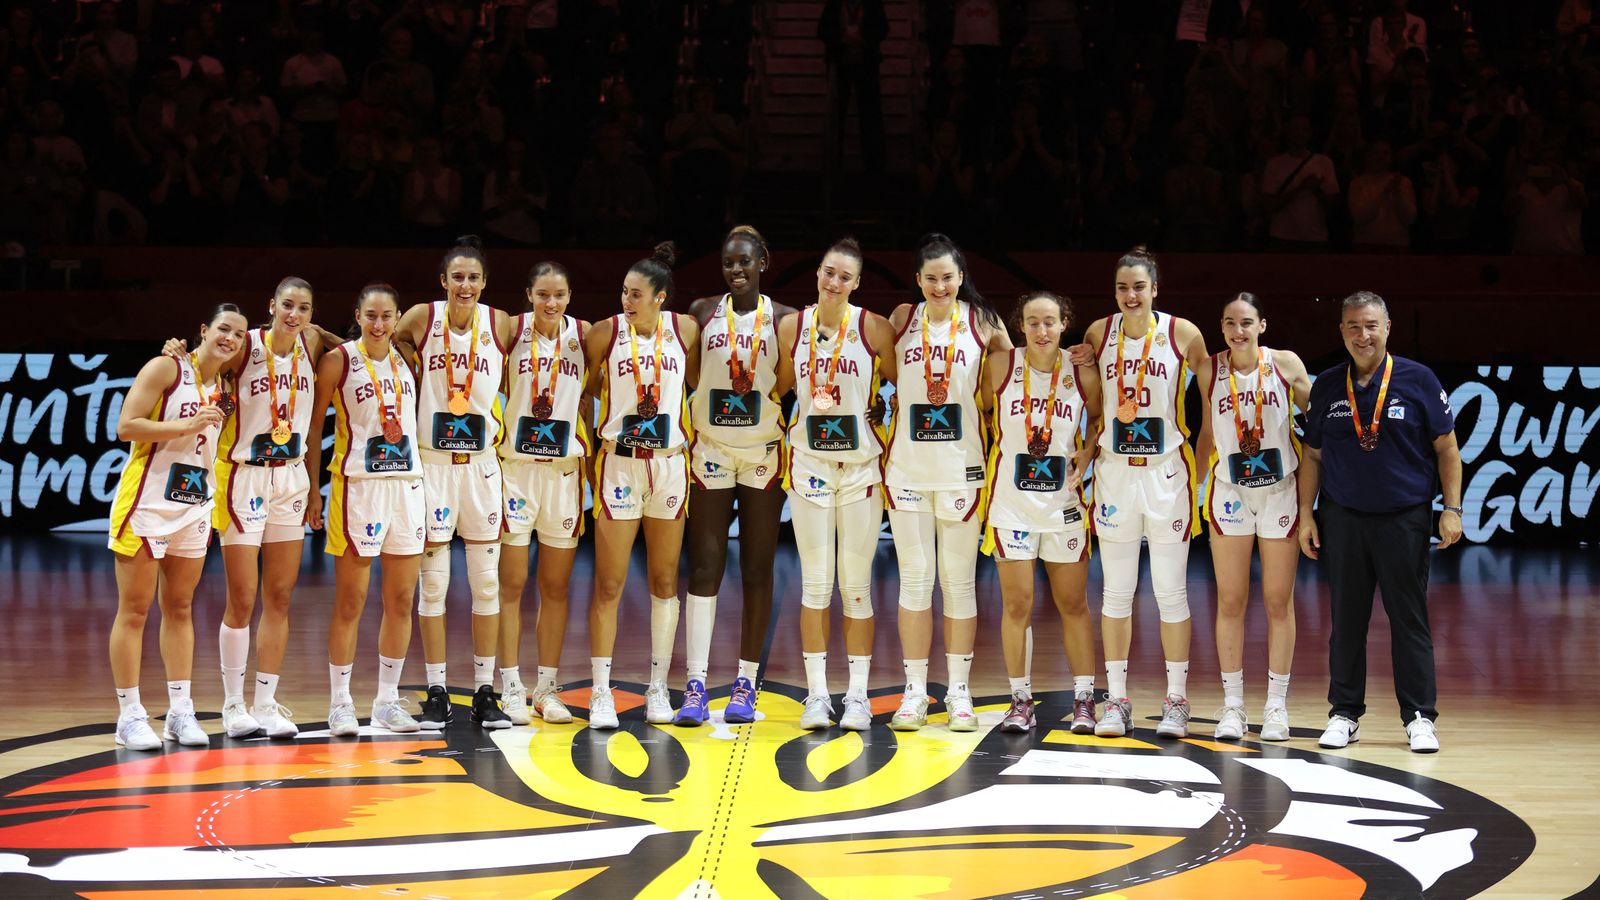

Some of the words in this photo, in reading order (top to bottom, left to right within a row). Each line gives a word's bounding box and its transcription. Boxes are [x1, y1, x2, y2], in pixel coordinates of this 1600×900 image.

[714, 416, 754, 425] CaixaBank
[916, 431, 957, 440] CaixaBank
[195, 433, 208, 456] 2
[438, 439, 478, 449] CaixaBank
[521, 443, 561, 455] CaixaBank
[814, 441, 853, 450] CaixaBank
[1119, 444, 1158, 453] CaixaBank
[371, 461, 409, 471] CaixaBank
[1019, 480, 1057, 490] CaixaBank
[1238, 476, 1278, 488] CaixaBank
